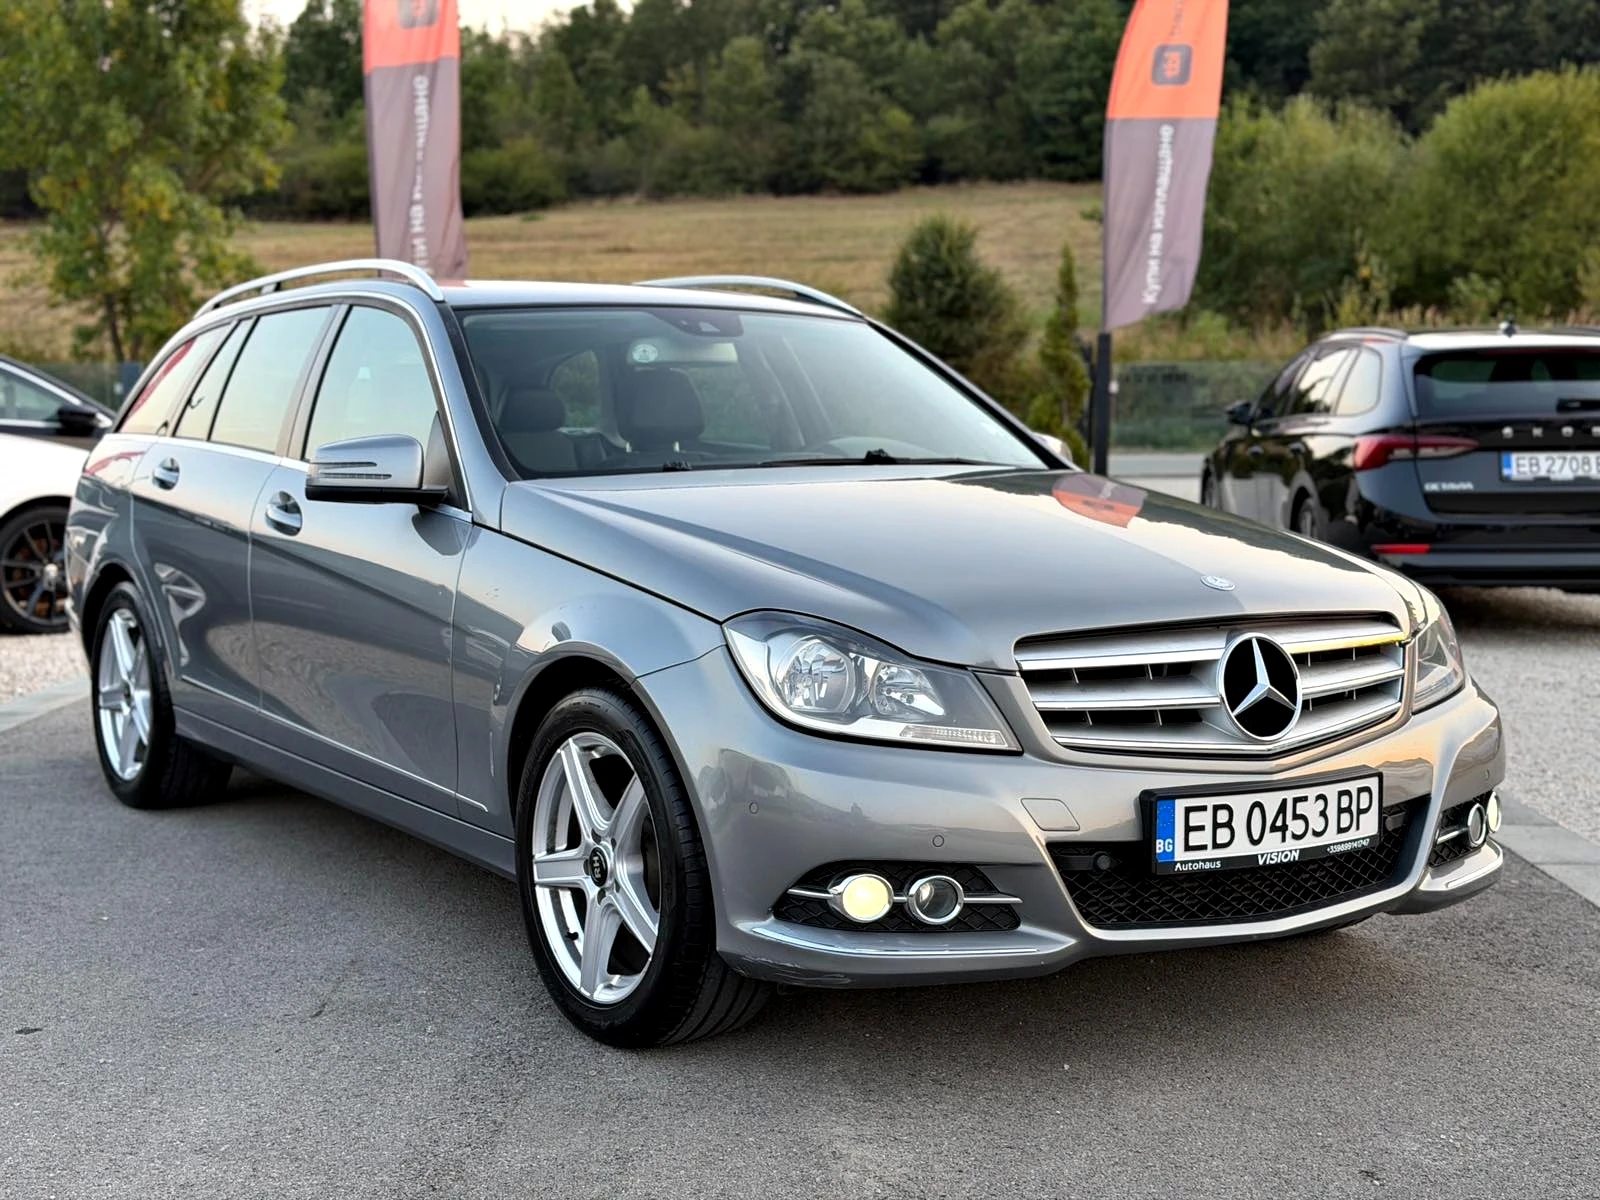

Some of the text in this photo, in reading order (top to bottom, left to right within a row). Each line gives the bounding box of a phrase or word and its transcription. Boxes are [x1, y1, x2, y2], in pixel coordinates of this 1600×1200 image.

[1149, 232, 1163, 257] на
[1142, 259, 1162, 304] Купи
[1516, 456, 1541, 475] EB
[1545, 455, 1593, 475] 2708
[1184, 785, 1373, 852] EB 0453 BP
[1156, 839, 1174, 853] BG
[1174, 860, 1221, 872] Autohaus
[1257, 850, 1300, 865] VISION
